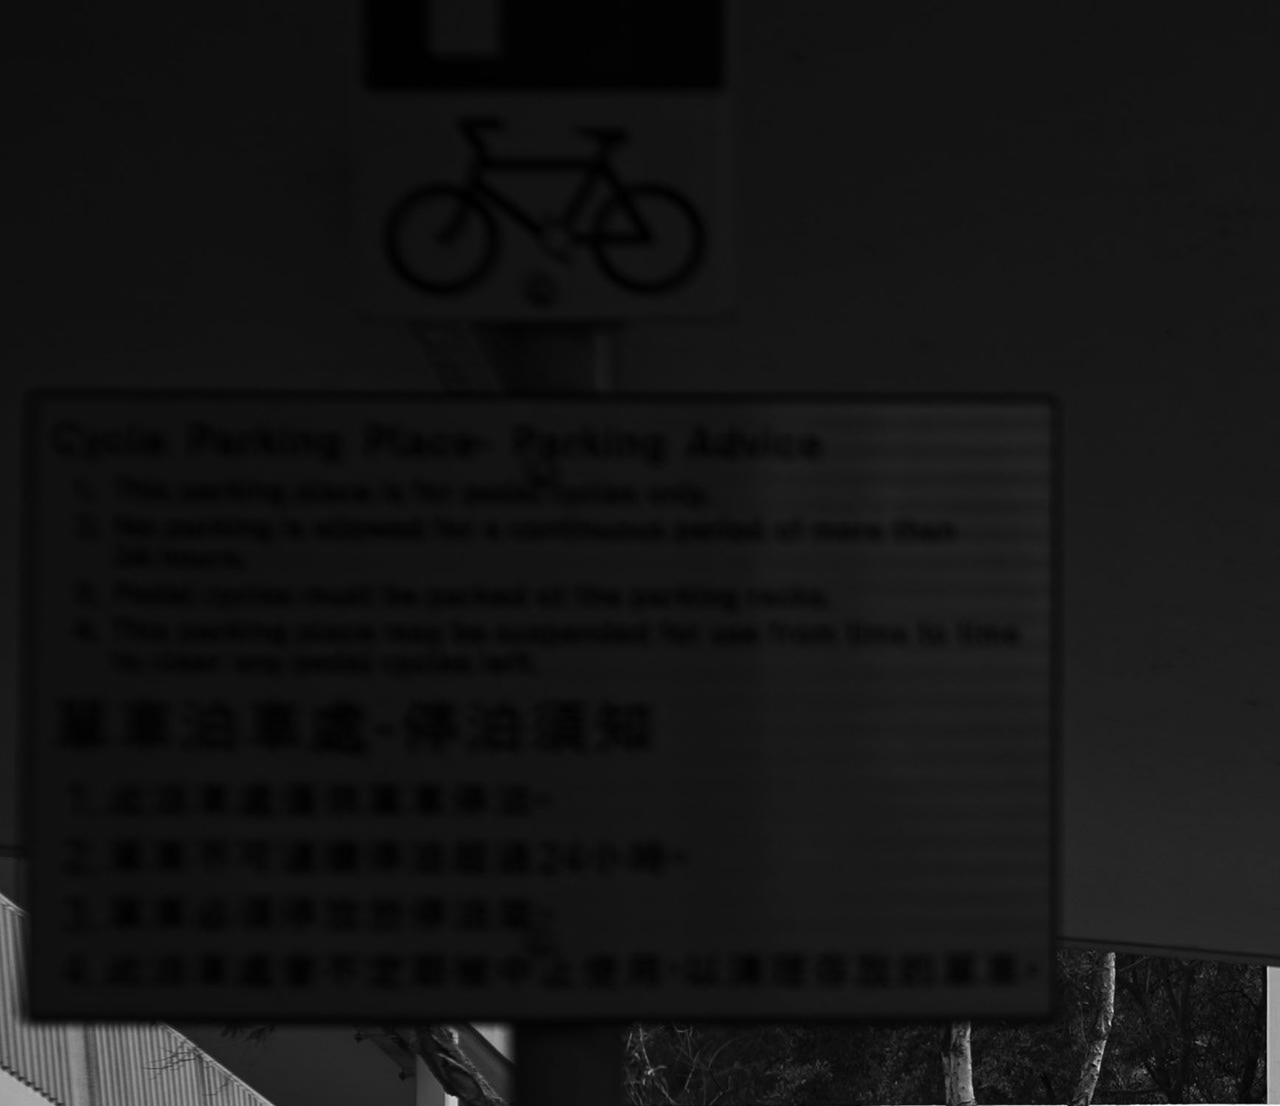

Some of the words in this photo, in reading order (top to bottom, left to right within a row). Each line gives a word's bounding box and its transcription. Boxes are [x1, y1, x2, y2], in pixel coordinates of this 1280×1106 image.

[49, 421, 165, 460] Cycle
[184, 422, 343, 463] Parking
[511, 424, 667, 466] Parking
[684, 424, 824, 461] Advice
[112, 476, 169, 503] This
[178, 478, 284, 507] parking
[295, 479, 370, 507] place
[412, 479, 451, 503] for
[462, 480, 542, 508] pedal
[165, 515, 271, 543] parking
[313, 515, 424, 541] allowed
[507, 517, 663, 542] continuous
[675, 518, 764, 545] period
[775, 518, 802, 543] of
[813, 520, 883, 544] more
[891, 518, 957, 543] than
[112, 580, 192, 606] Pedal
[304, 584, 371, 607] must
[426, 583, 526, 612] parked
[572, 583, 620, 609] the
[629, 584, 739, 613] parking
[110, 616, 168, 643] This
[178, 618, 287, 647] parking
[295, 619, 374, 647] place
[495, 620, 650, 648] suspended
[844, 620, 909, 646] time
[916, 621, 948, 646] to
[956, 619, 1020, 646] time
[293, 652, 371, 679] pedal
[51, 699, 652, 754] 單車泊車處-停泊須知
